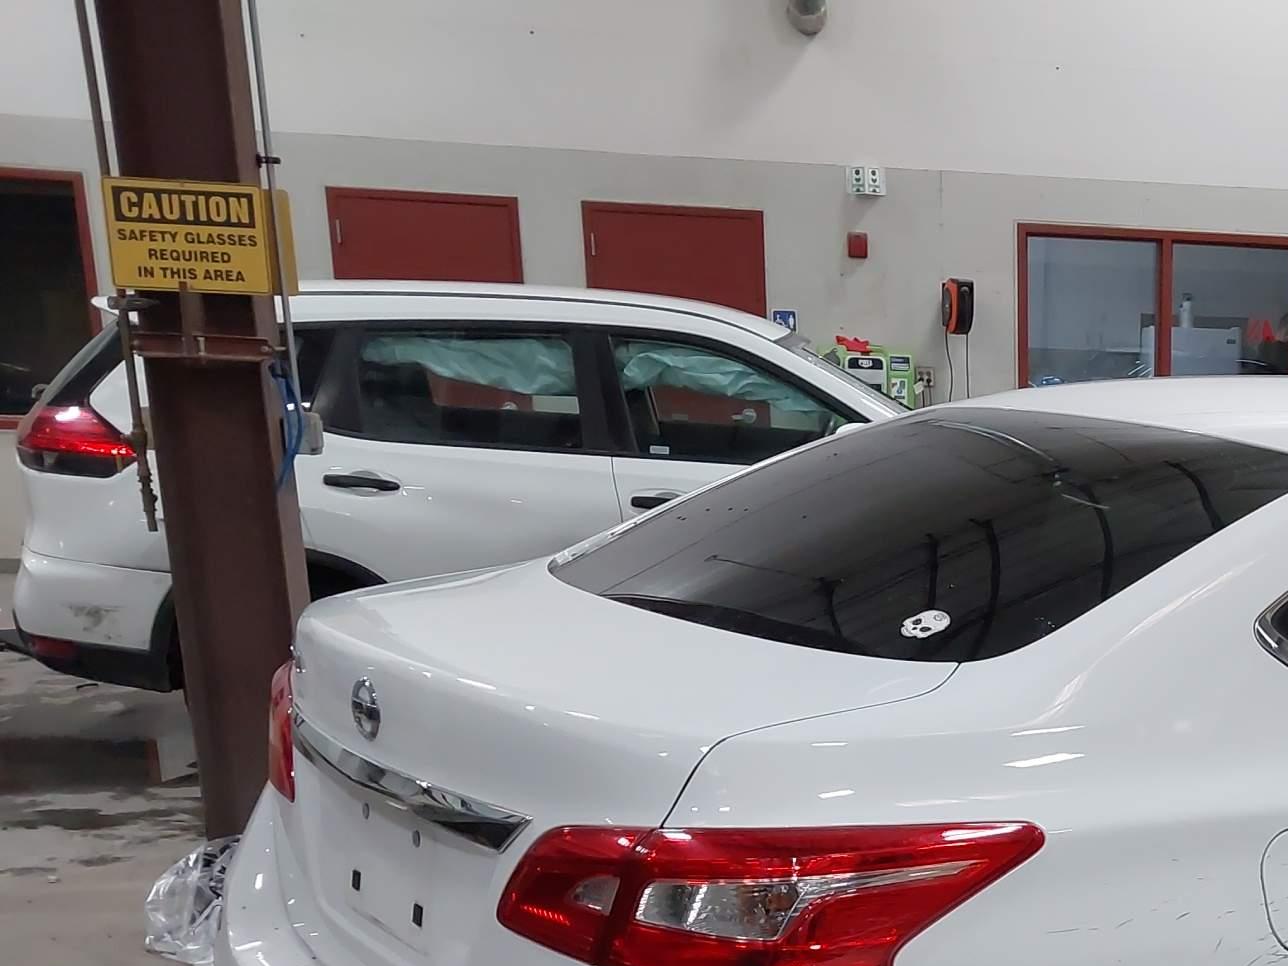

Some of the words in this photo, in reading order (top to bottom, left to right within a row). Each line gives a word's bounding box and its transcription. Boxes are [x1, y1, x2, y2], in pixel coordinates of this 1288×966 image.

[119, 191, 250, 224] CAUTION
[117, 228, 178, 243] SAFETY
[184, 231, 257, 247] GLASSES
[148, 248, 231, 263] REQUIRED
[138, 266, 154, 279] IN
[160, 267, 197, 280] THIS
[203, 269, 246, 282] AREA
